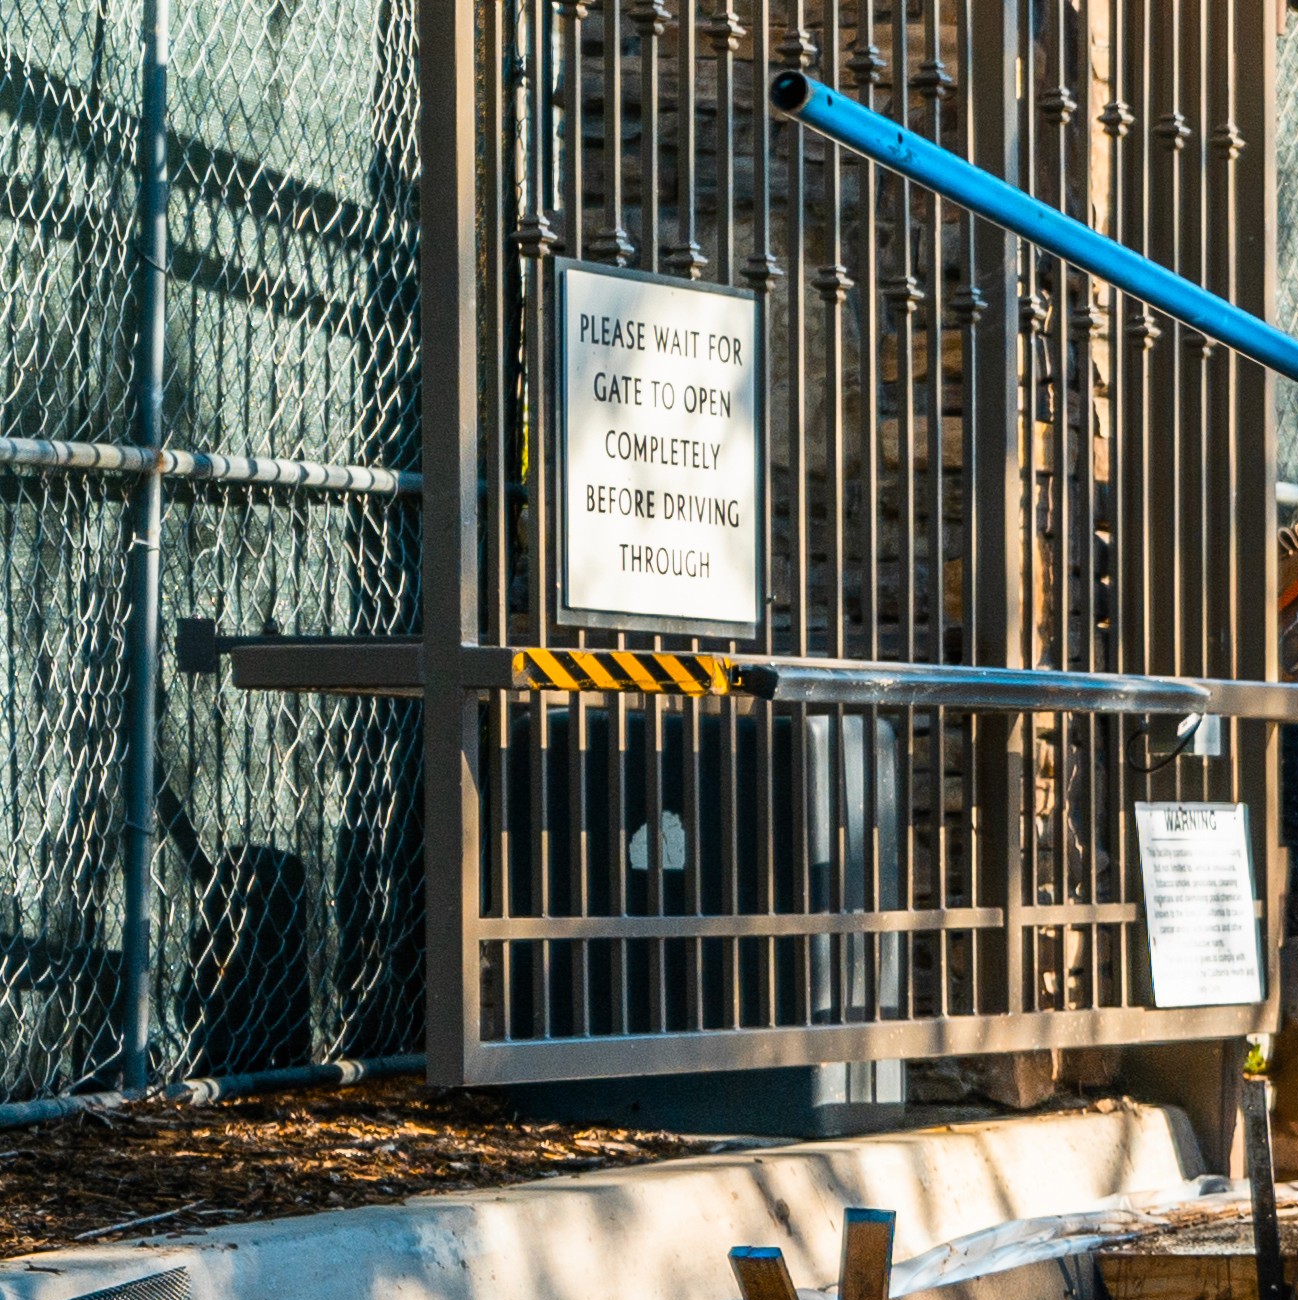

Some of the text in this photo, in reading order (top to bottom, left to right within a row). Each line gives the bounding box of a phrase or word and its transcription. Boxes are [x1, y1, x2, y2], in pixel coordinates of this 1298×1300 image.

[580, 313, 743, 366] PLEASE WAIT FOR
[593, 372, 731, 419] GATE TO OPEN
[605, 429, 721, 471] COMPLETELY
[586, 484, 740, 528] BEFORE DRIVING
[619, 543, 711, 579] THROUGH
[1164, 808, 1217, 831] WARNING
